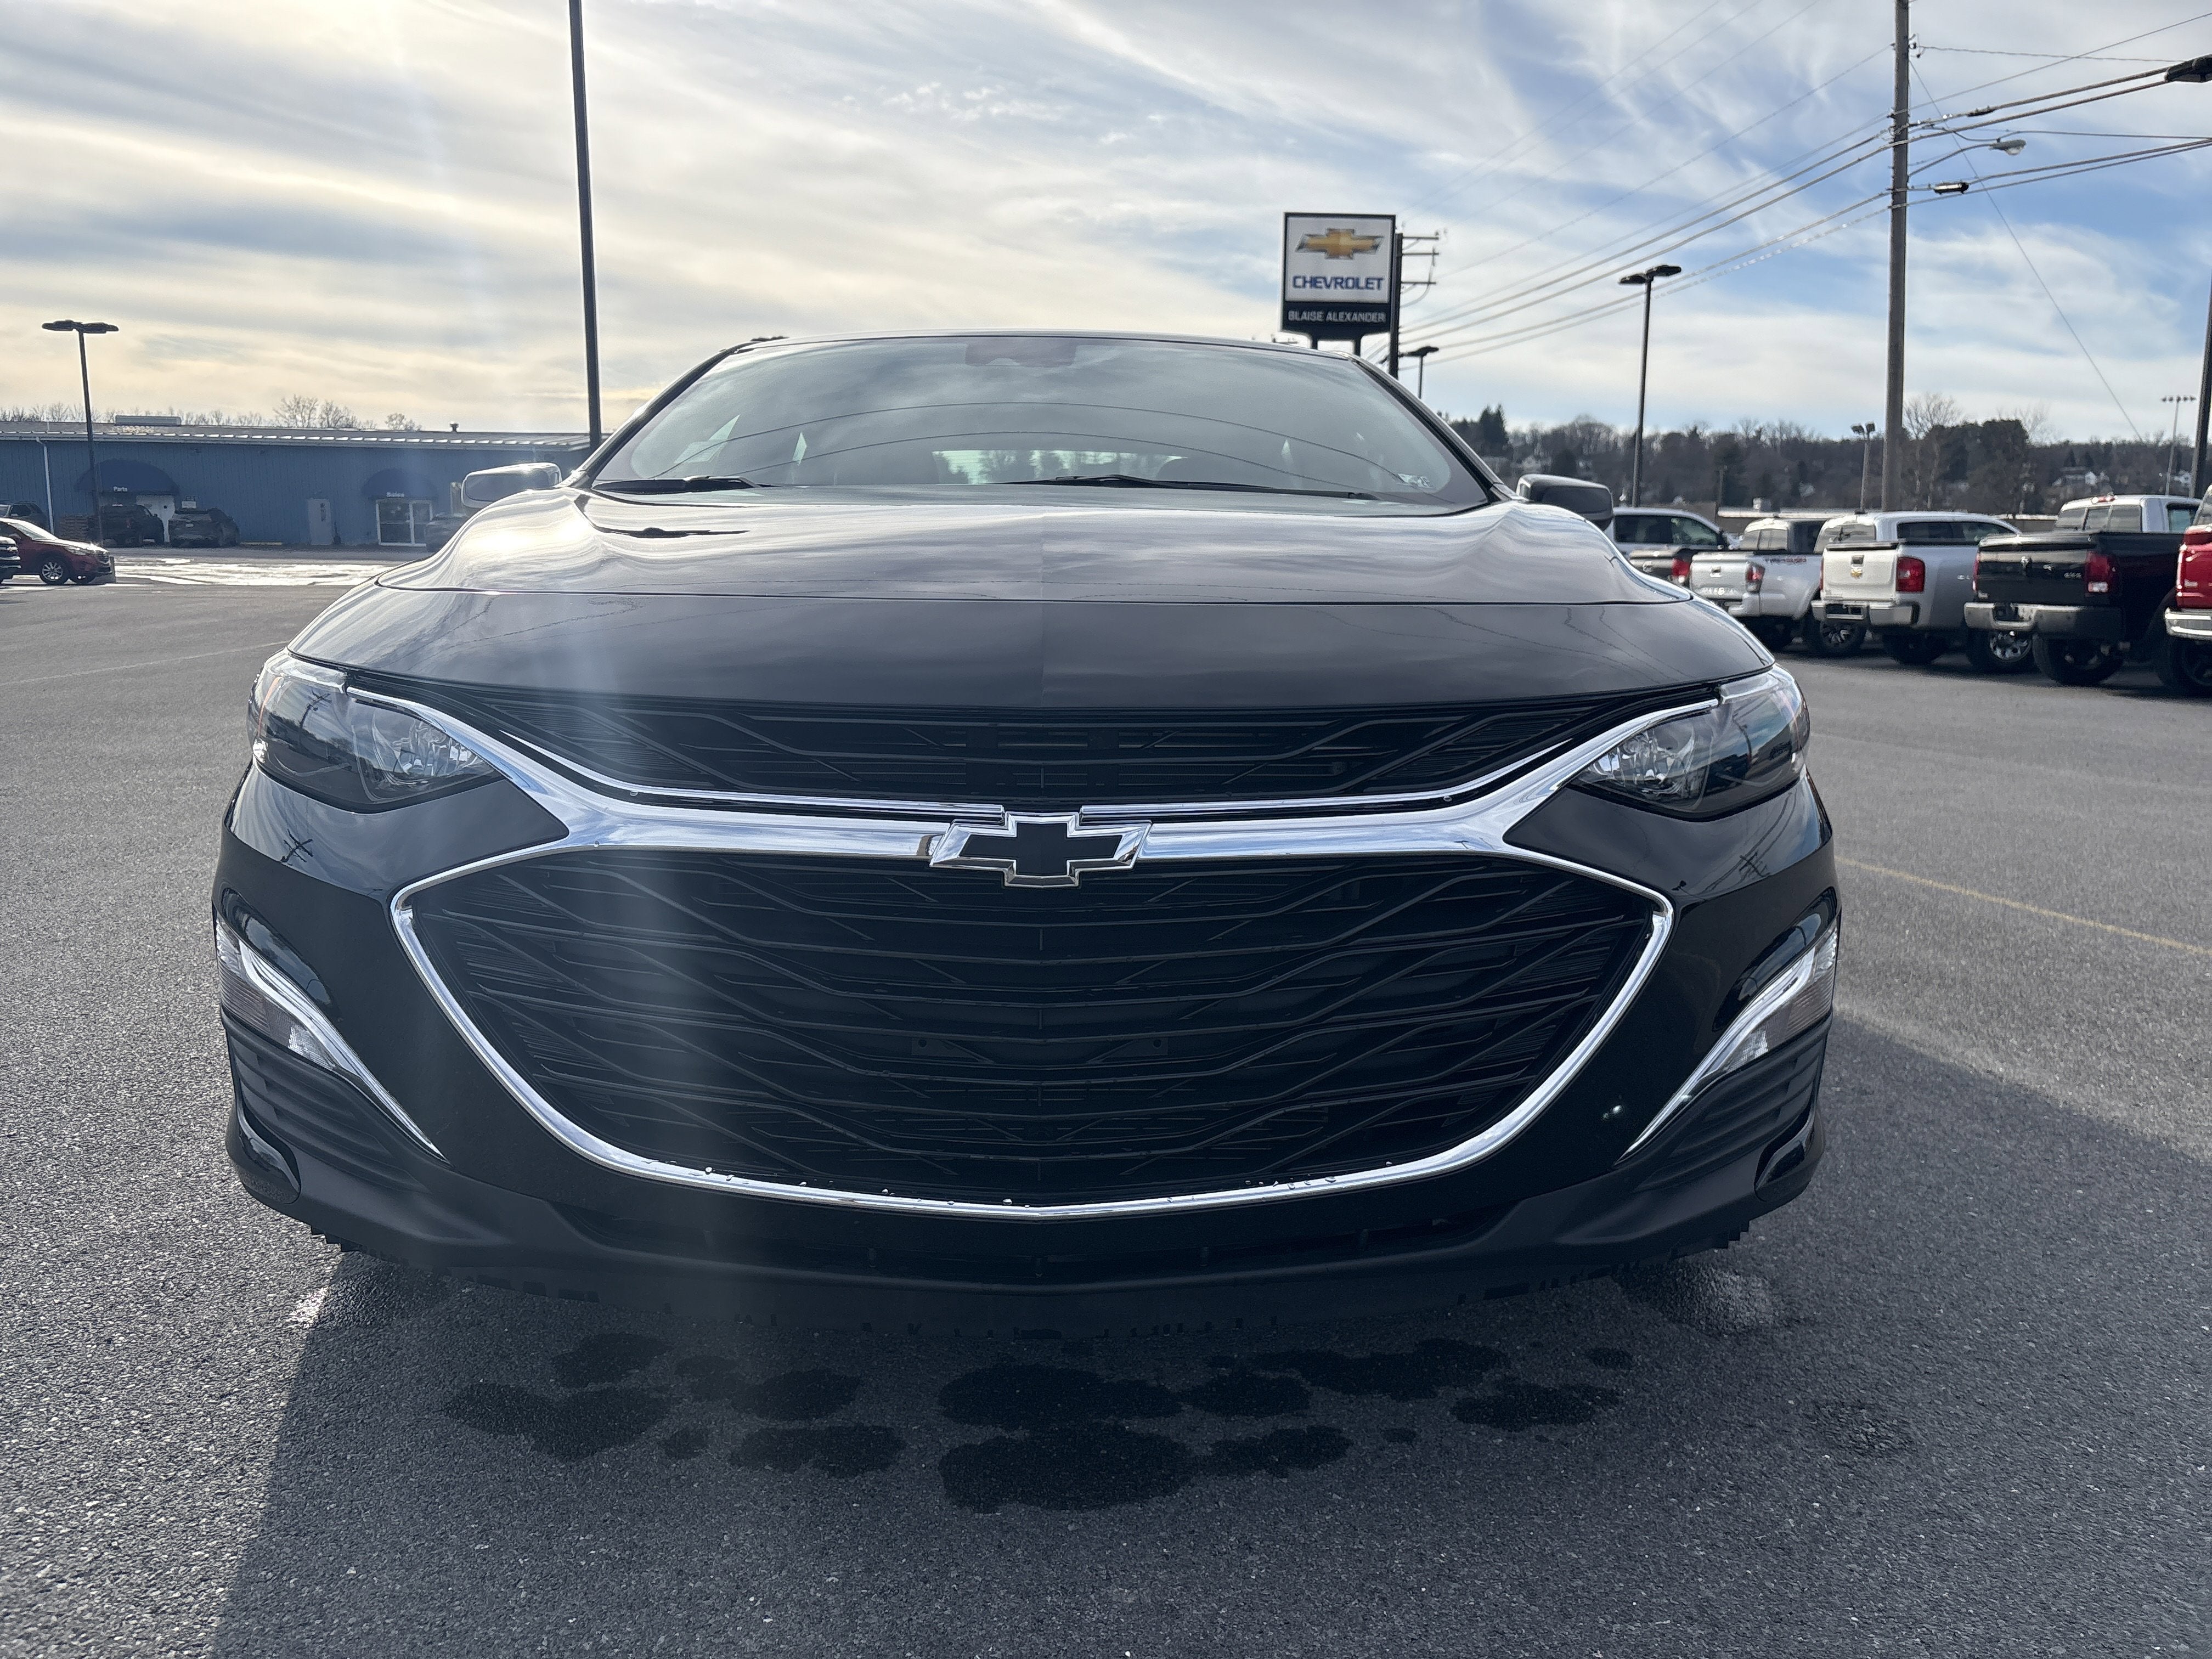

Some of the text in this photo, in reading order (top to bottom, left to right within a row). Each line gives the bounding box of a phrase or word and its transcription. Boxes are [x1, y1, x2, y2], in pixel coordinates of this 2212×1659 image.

[1293, 275, 1384, 290] CHEVROLET
[1288, 310, 1386, 323] BLAISE ALEXANDER
